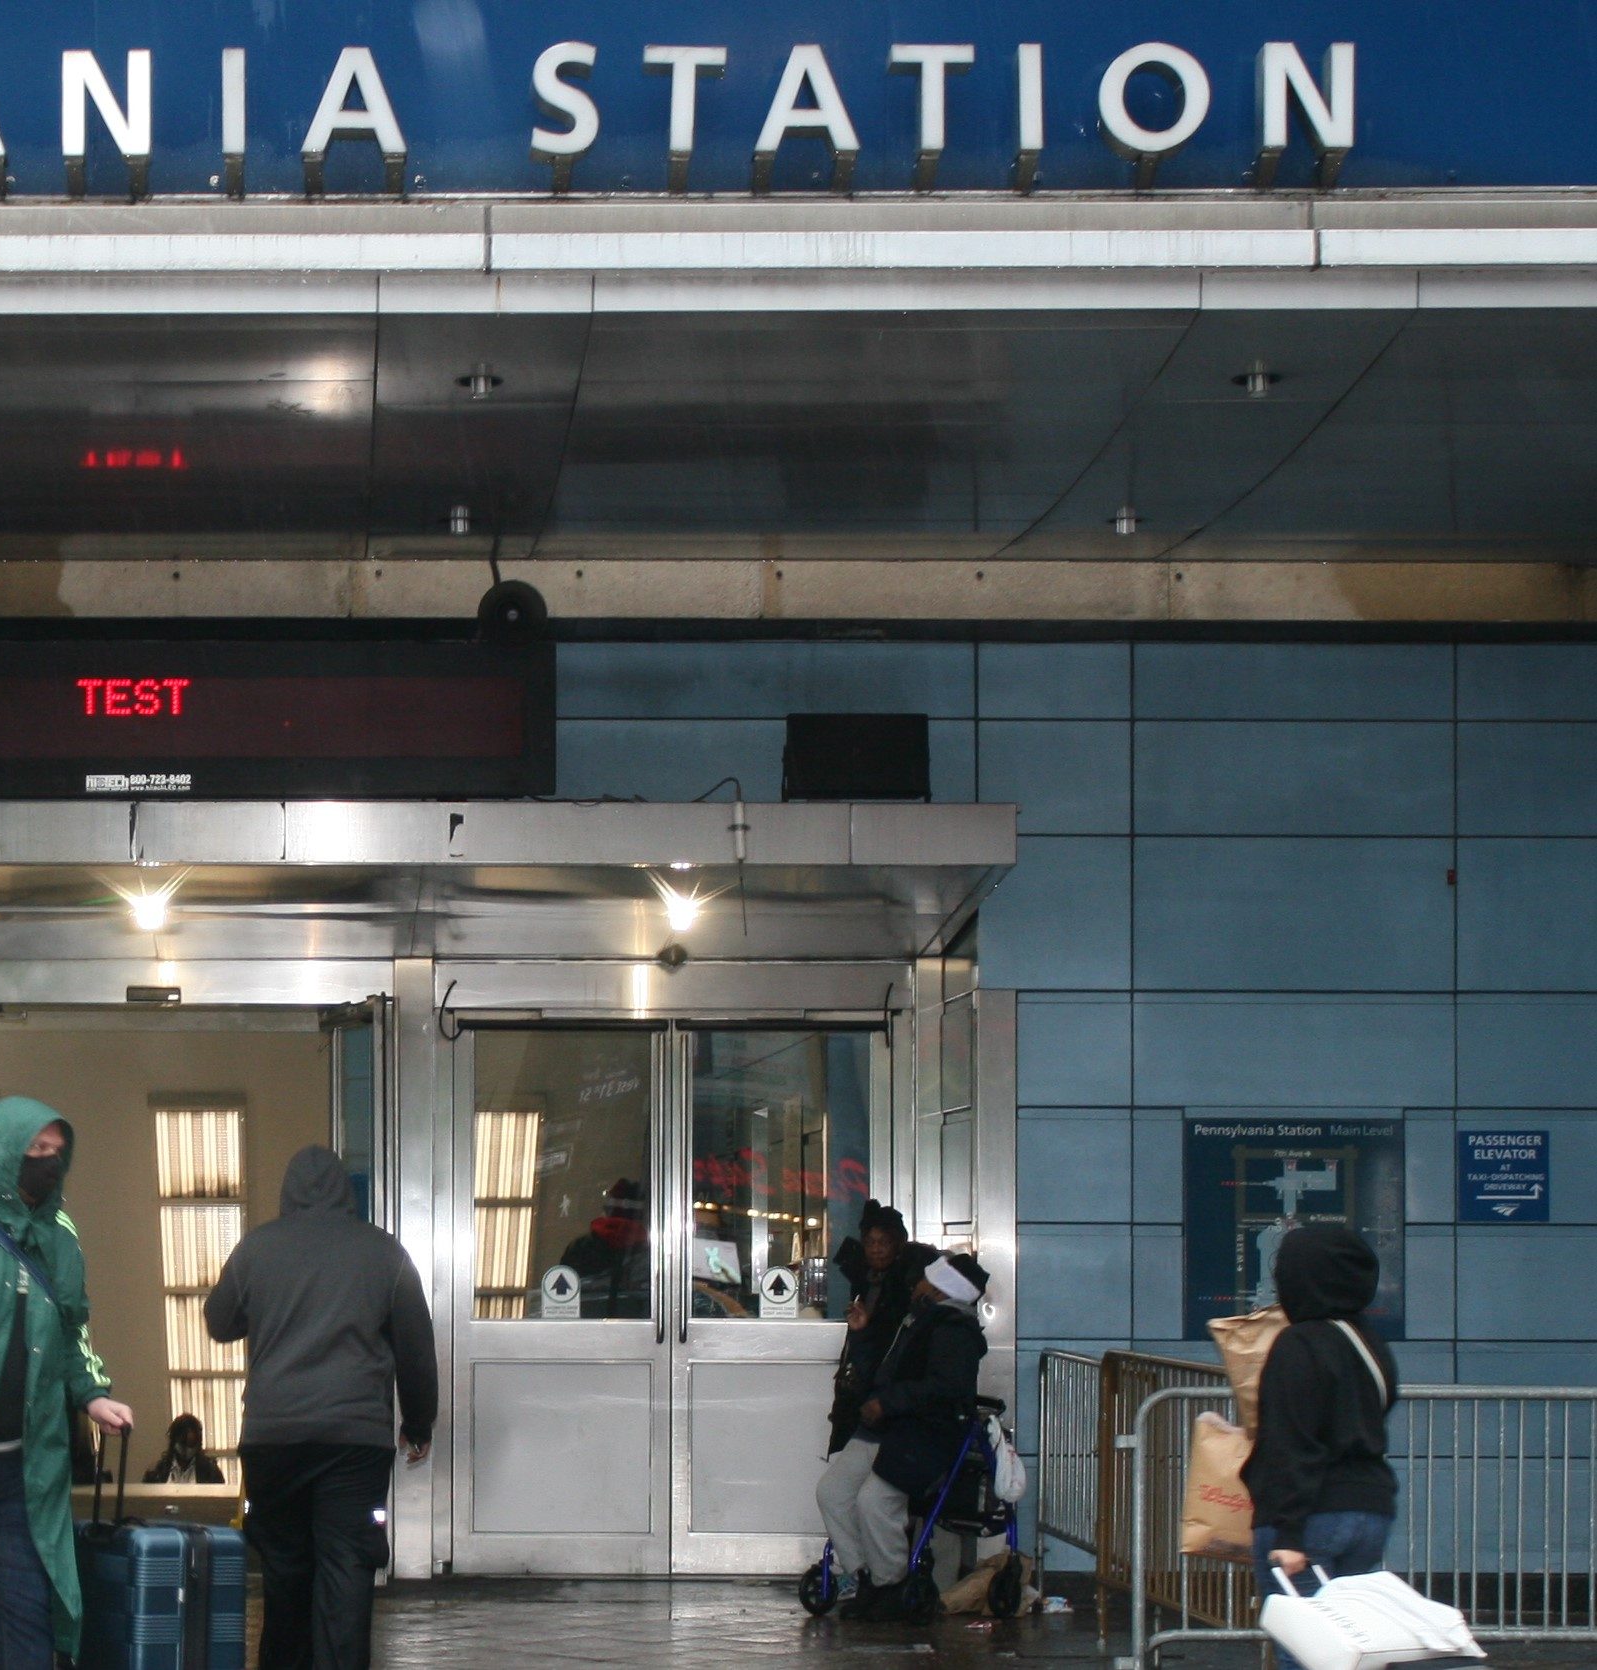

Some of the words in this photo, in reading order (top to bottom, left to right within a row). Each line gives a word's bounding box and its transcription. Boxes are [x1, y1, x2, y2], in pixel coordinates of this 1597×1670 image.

[530, 40, 1354, 154] STATION
[76, 678, 189, 716] TEST
[1194, 1124, 1274, 1138] Pennsylvania
[1278, 1124, 1322, 1136] Station
[1330, 1125, 1361, 1136] Main
[1363, 1124, 1393, 1136] Level
[1468, 1135, 1542, 1146] PASSENGER
[1474, 1149, 1536, 1160] ELEVATOR
[1484, 1183, 1527, 1191] DRIVEWAY
